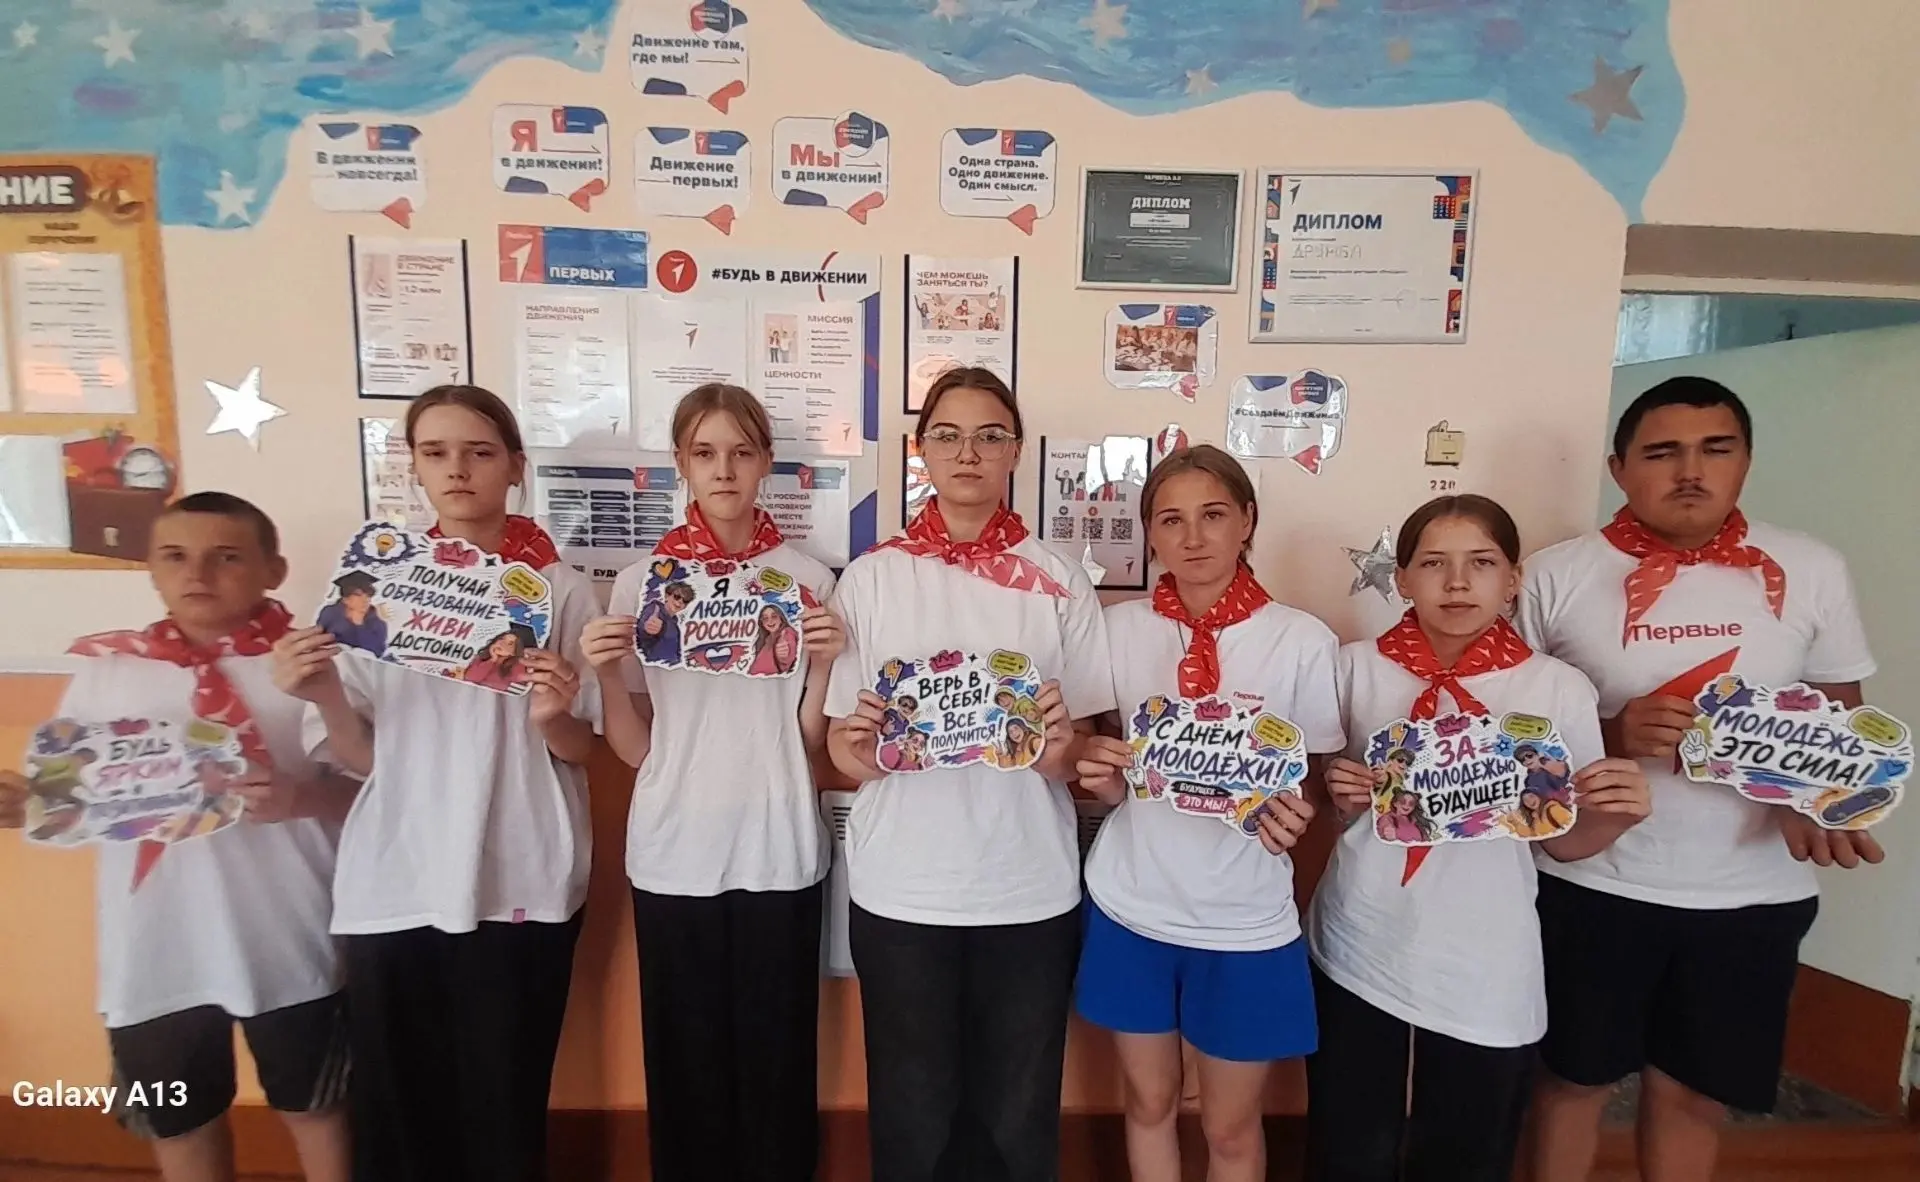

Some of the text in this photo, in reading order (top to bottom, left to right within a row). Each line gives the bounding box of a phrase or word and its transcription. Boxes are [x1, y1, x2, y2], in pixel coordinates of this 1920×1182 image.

[632, 33, 745, 52] Движение там,
[632, 52, 690, 65] где мы!
[510, 119, 539, 152] Я
[500, 157, 603, 172] в движении!
[649, 156, 735, 173] Движение
[790, 143, 840, 168] Мы
[959, 155, 1039, 169] Одна страна.
[337, 168, 418, 182] навсегда!
[672, 175, 739, 189] первых!
[781, 170, 882, 184] в движении!
[948, 166, 1049, 181] Одно движение.
[958, 178, 1037, 192] Один смысл.
[1131, 196, 1191, 209] ДИПЛОМ
[1293, 213, 1383, 232] ДИПЛОМ
[549, 265, 617, 282] ПЕРВЫХ
[711, 267, 868, 284] #БУДЬ В ДВИЖЕНИИ
[940, 271, 989, 281] МОЖЕШЬ
[916, 279, 968, 288] ЗАНЯТЬСЯ
[807, 315, 854, 324] МИССИЯ
[764, 370, 823, 380] ЦЕННОСТИ
[405, 564, 493, 598] ПОЛУЧАЙ
[711, 577, 730, 598] Я
[689, 598, 760, 620] ЛЮБЛЮ
[402, 608, 475, 641] ЖИВИ
[683, 618, 758, 646] РОССИЮ
[1632, 622, 1743, 644] Первые
[386, 631, 475, 662] ДОСТОЙНО
[968, 671, 981, 688] В
[938, 683, 991, 711] СЕБЯ!
[931, 716, 1003, 752] ПОЛУЧИТСЯ!
[1155, 719, 1174, 740] С
[1174, 722, 1245, 750] ДНЁМ
[1713, 708, 1865, 757] МОЛОДЁЖЬ
[1434, 735, 1476, 767] ЗА
[1143, 743, 1288, 787] МОЛОДЁЖИ!
[1714, 736, 1875, 789] ЭТО СИЛА!
[1179, 784, 1216, 796] БУДУЩЕЕ
[1427, 773, 1520, 817] БУДУЩЕЕ!
[1182, 798, 1227, 811] ЭТО МЫ!
